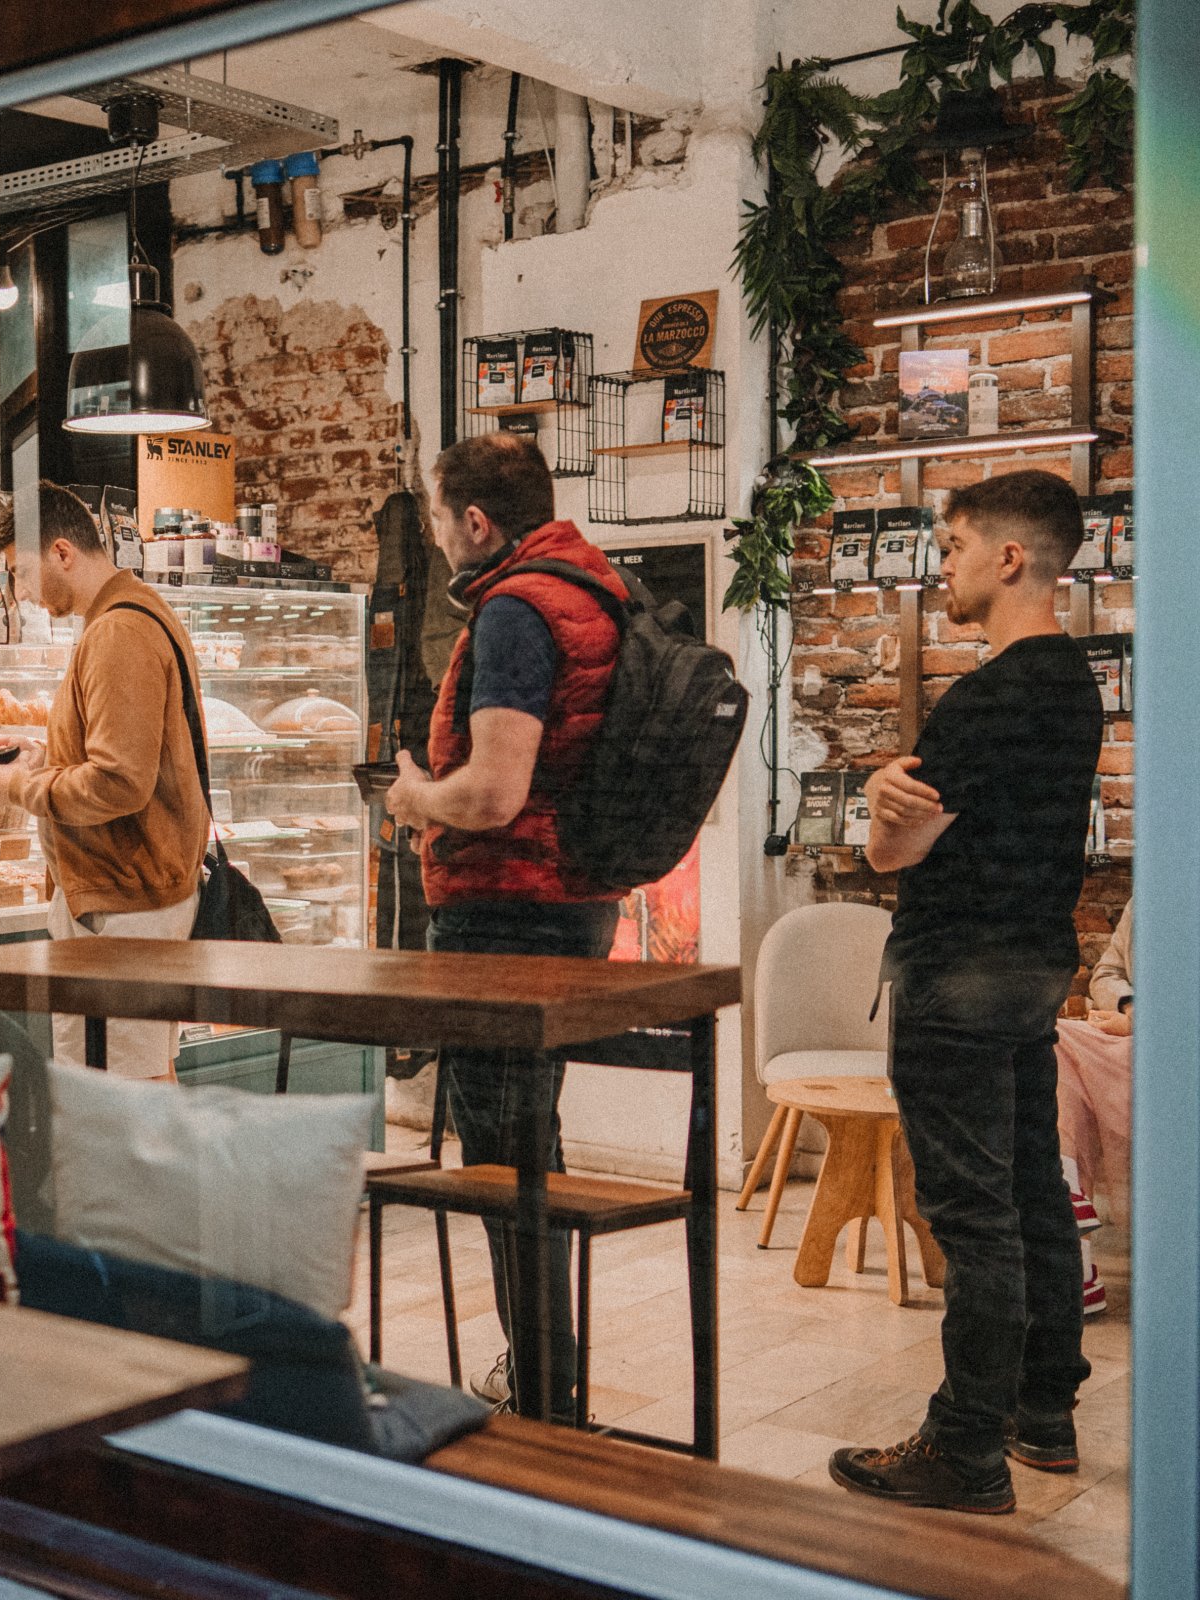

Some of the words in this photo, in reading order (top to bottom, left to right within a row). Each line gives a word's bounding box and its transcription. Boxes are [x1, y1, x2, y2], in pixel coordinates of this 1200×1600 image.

[649, 311, 665, 328] OUR
[668, 304, 704, 322] ESPRESSO
[643, 333, 654, 344] LA
[656, 325, 706, 342] MARZOCCO
[167, 438, 232, 459] STANLEY
[607, 556, 621, 565] THE
[623, 555, 644, 565] WEEK
